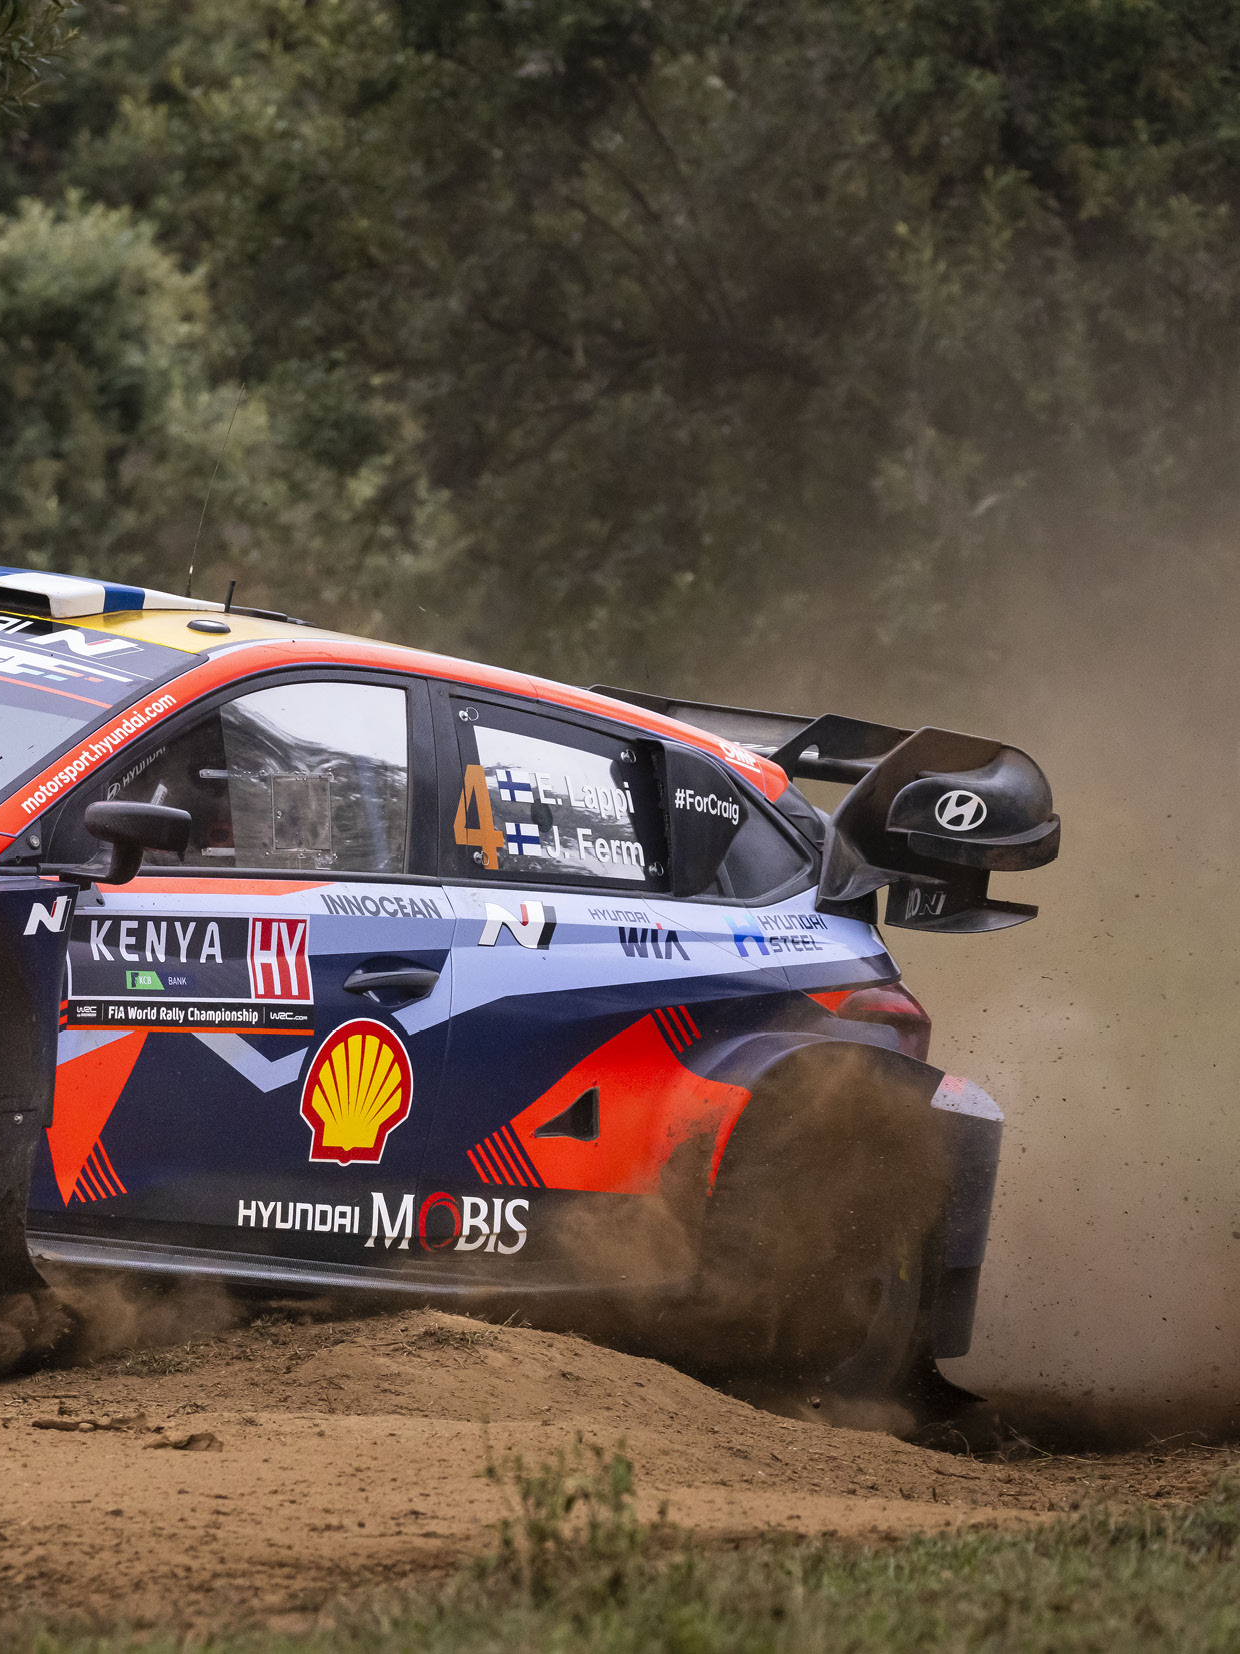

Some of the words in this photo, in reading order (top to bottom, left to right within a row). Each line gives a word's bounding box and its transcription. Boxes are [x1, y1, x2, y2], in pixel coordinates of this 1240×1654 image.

[21, 694, 177, 814] motorsport.hyundai.com
[534, 773, 562, 805] E.
[564, 776, 634, 819] Lappi
[675, 788, 740, 825] #ForCraig
[453, 764, 504, 870] 4
[546, 825, 569, 859] J.
[576, 827, 646, 867] Ferm
[320, 894, 443, 919] INNOCEAN
[588, 908, 651, 924] HYUNDAI
[759, 914, 829, 930] HYUNDAI
[90, 920, 223, 963] KENYA
[253, 921, 305, 996] HY
[768, 935, 824, 953] STEEL
[138, 976, 152, 985] KCB
[168, 976, 188, 986] BANK
[127, 1006, 157, 1020] World
[160, 1007, 186, 1024] Rally
[188, 1007, 259, 1024] Championship
[237, 1200, 360, 1234] HYUNDAI
[364, 1191, 530, 1255] MOBIS
